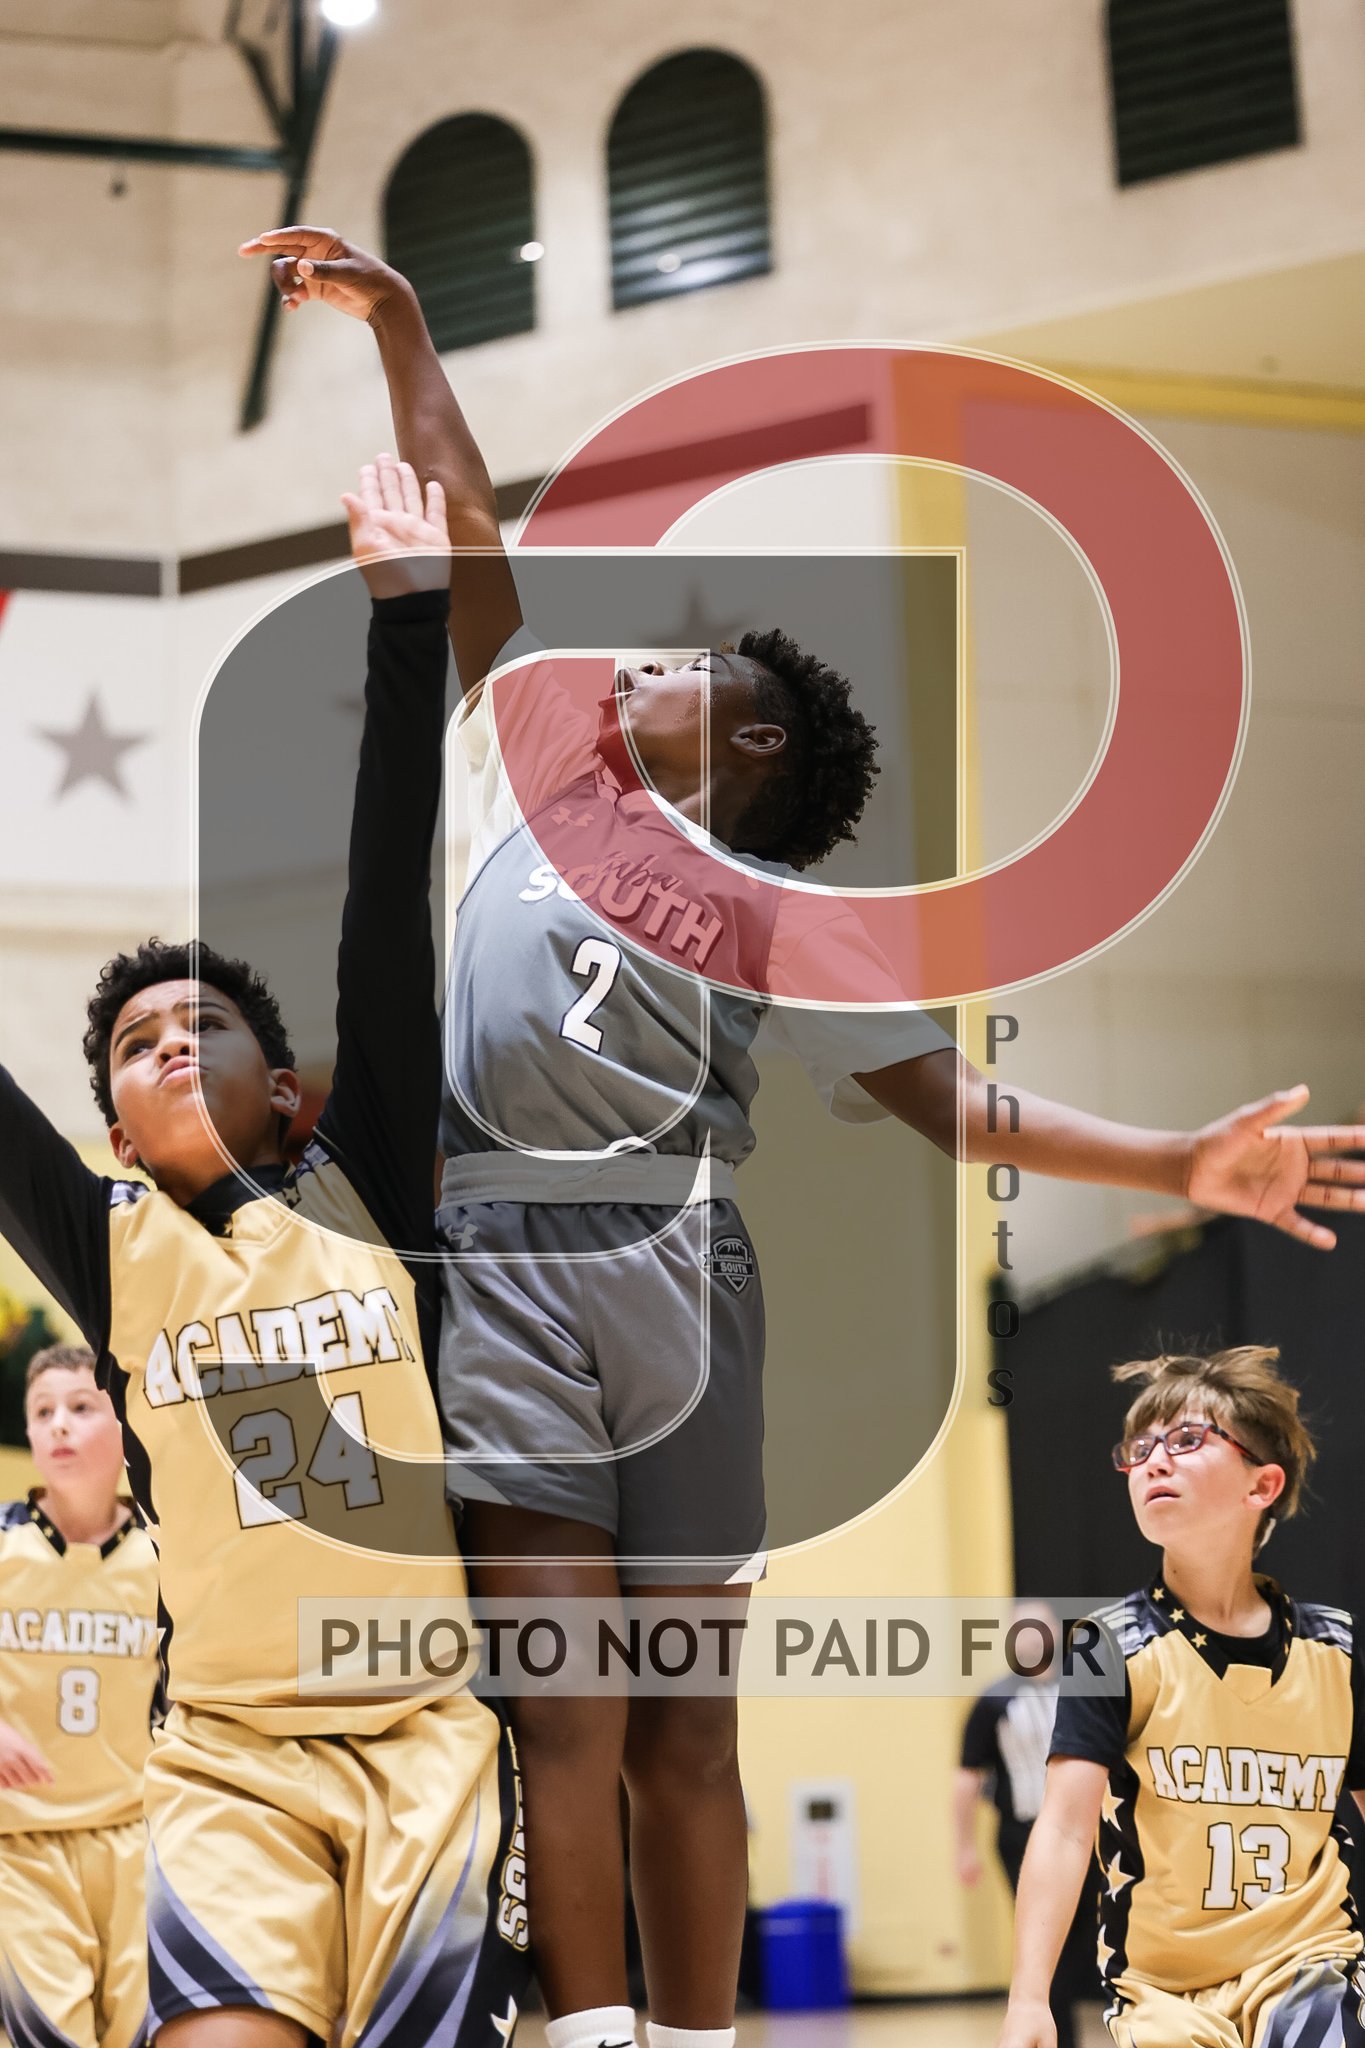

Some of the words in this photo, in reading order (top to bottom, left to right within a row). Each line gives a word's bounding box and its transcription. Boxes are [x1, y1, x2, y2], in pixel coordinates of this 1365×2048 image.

[518, 862, 724, 973] SOUTH
[559, 936, 622, 1054] 2
[720, 1261, 748, 1275] SOUTH
[229, 1392, 384, 1530] 24
[57, 1664, 100, 1737] 8
[1147, 1745, 1347, 1812] ACADEMY
[1202, 1822, 1291, 1911] 13
